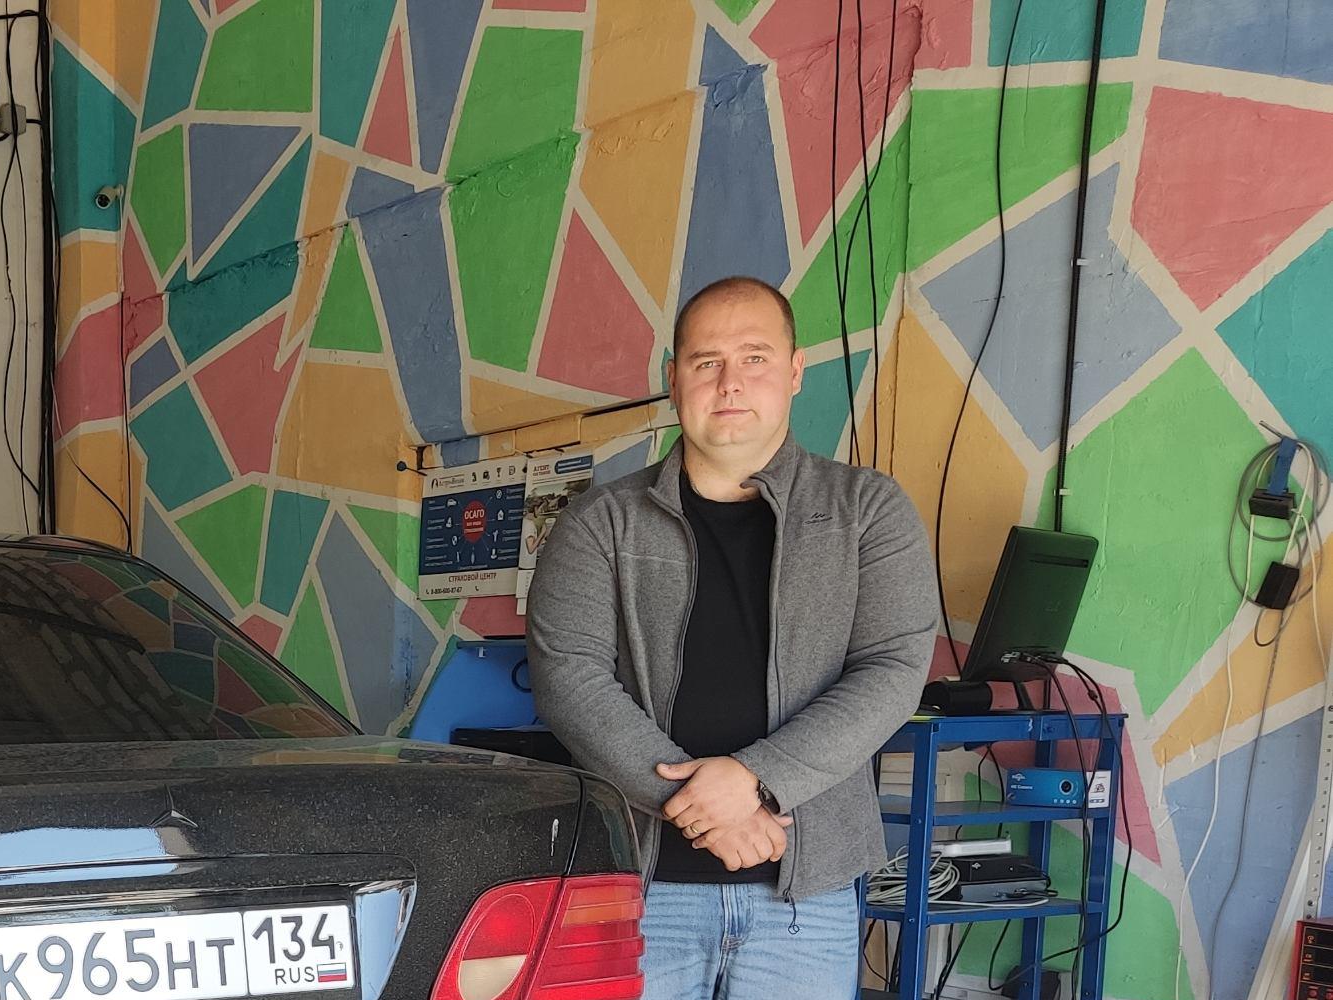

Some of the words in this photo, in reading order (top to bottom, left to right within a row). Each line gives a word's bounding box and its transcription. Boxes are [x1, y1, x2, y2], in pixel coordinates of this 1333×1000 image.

[464, 509, 485, 520] ОСАГО
[252, 913, 336, 964] 134
[274, 966, 315, 985] RUS
